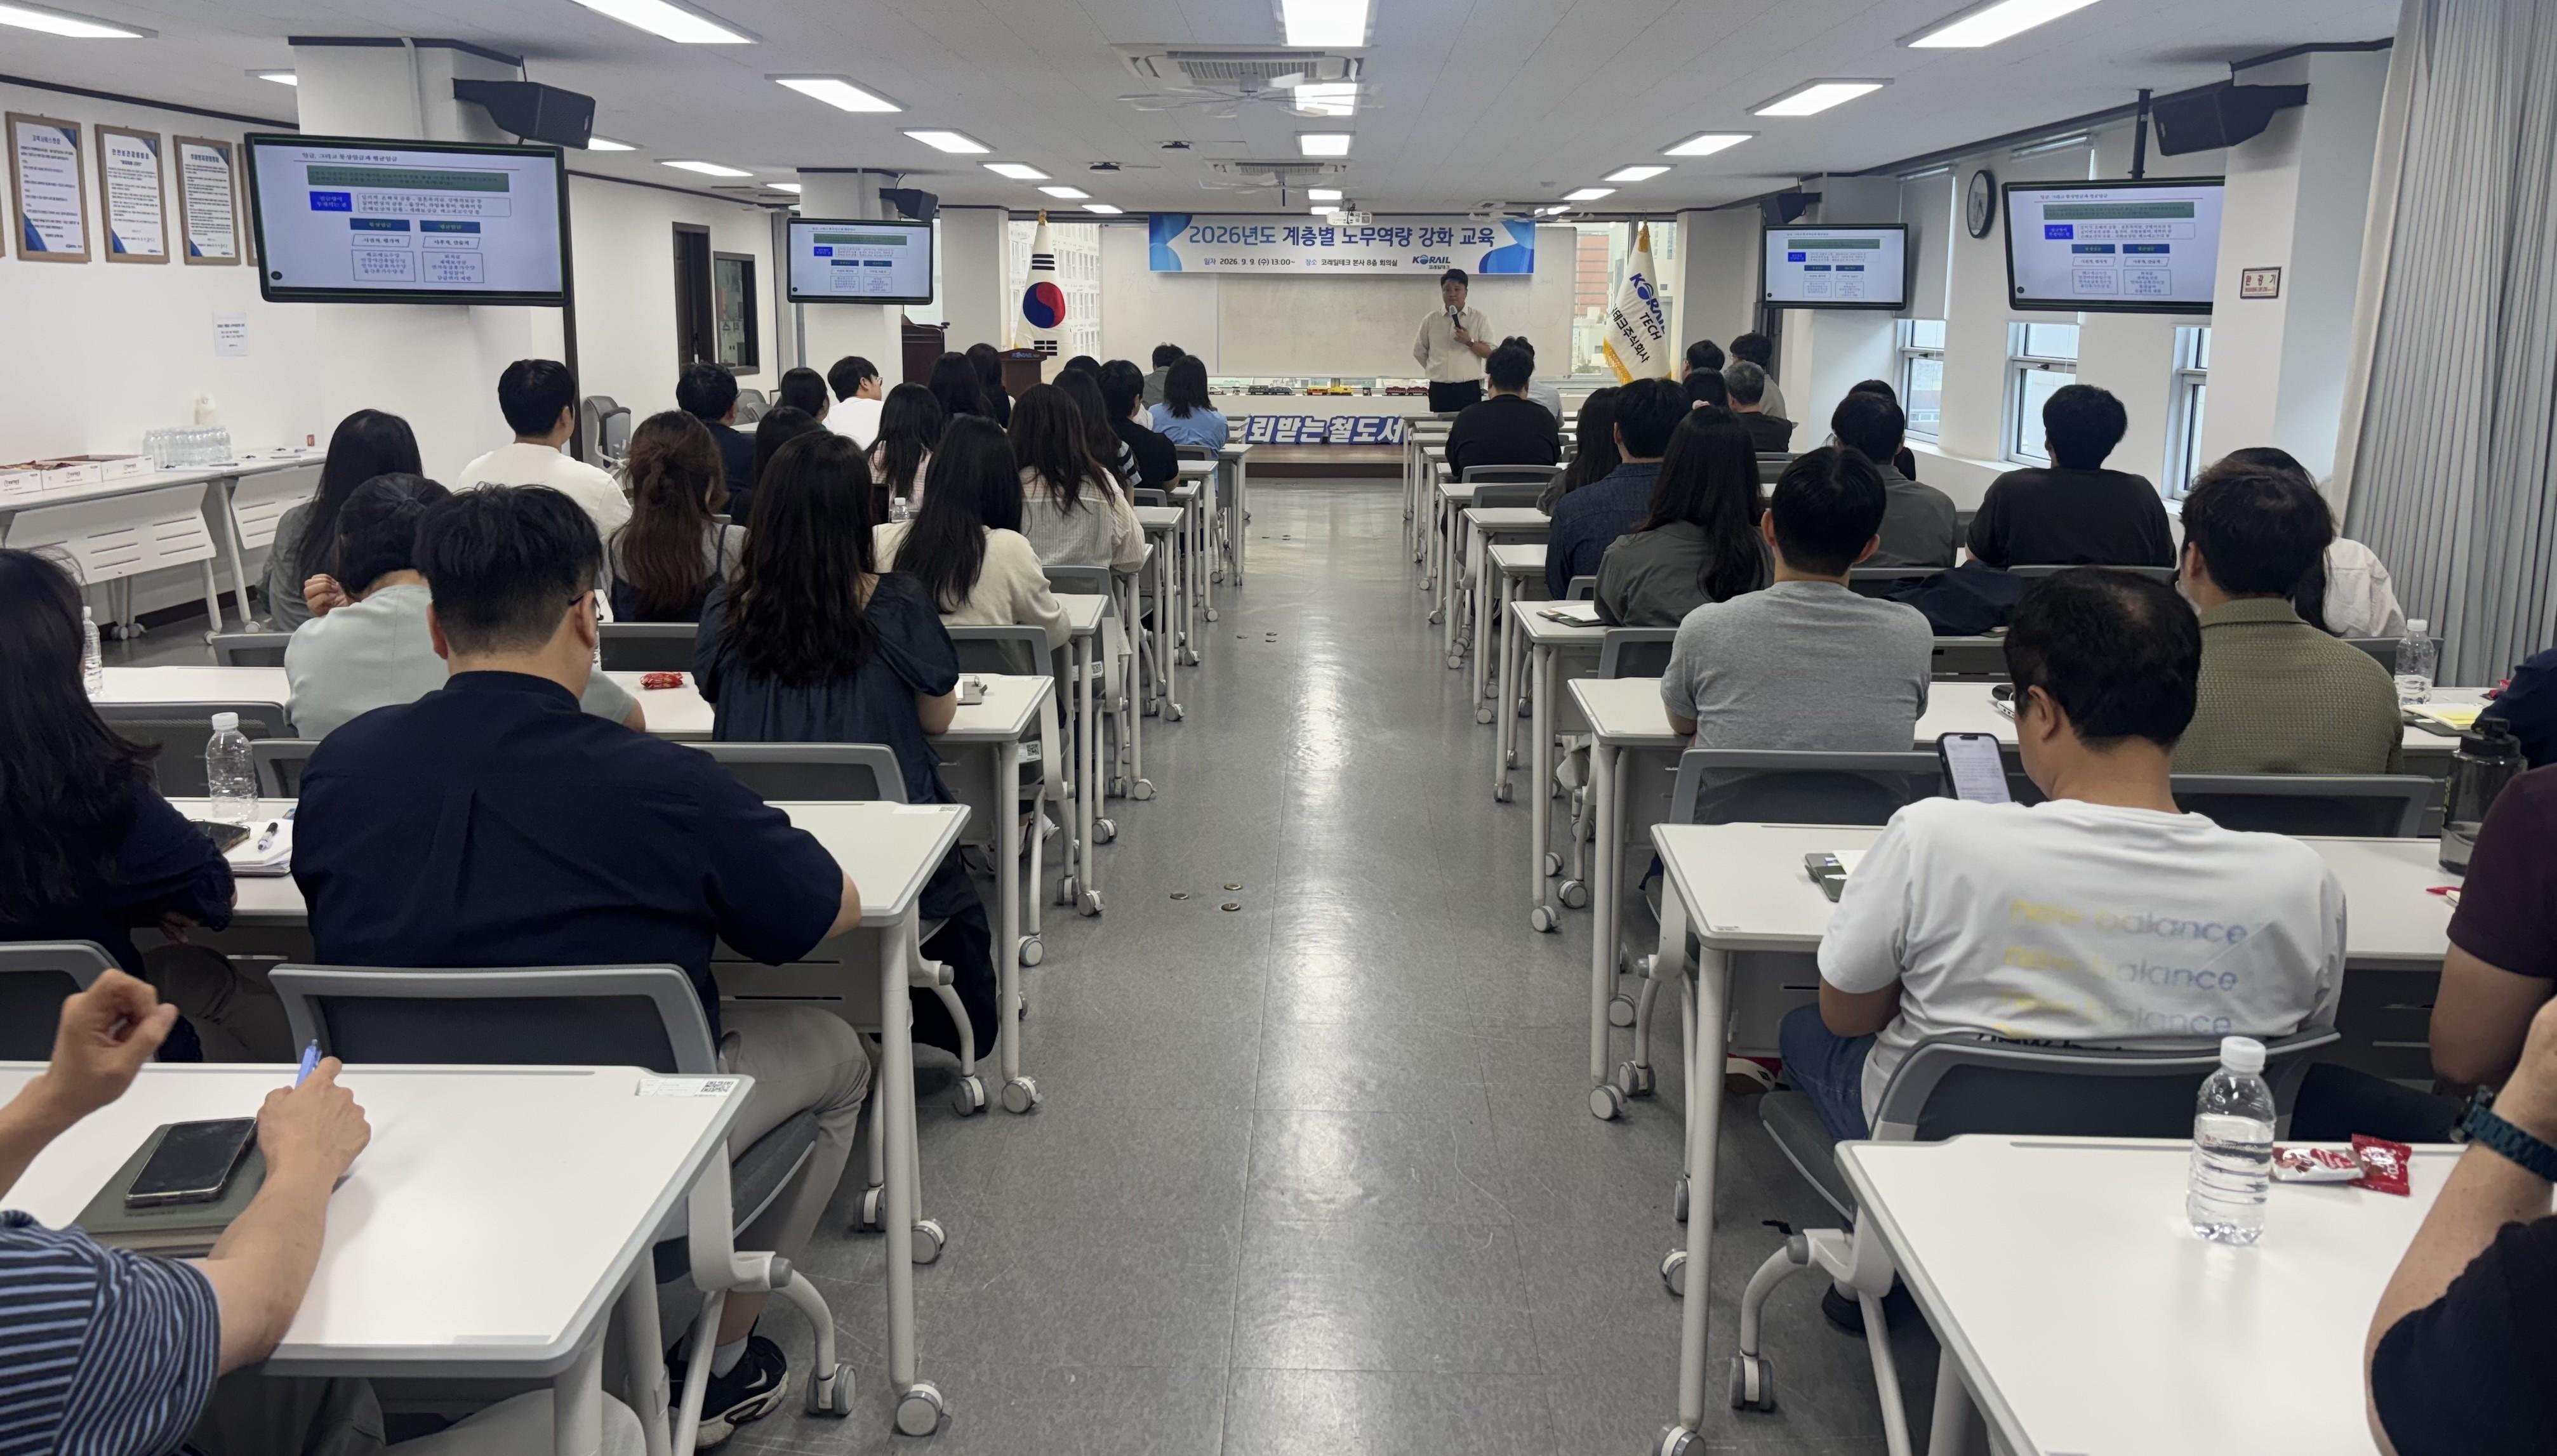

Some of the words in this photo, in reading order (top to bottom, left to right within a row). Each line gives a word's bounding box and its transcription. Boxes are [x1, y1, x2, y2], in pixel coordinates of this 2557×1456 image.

[1189, 226, 1276, 246] 2026년도
[1282, 226, 1335, 246] 계층별
[1341, 227, 1413, 247] 노무역량
[1419, 227, 1454, 247] 강화
[1459, 227, 1495, 247] 교육
[1412, 255, 1451, 265] KORAIL
[1613, 304, 1650, 363] 테크주식회사
[1640, 312, 1662, 340] TECH
[1245, 416, 1325, 443] 뢰받는
[1330, 417, 1412, 443] 철도서
